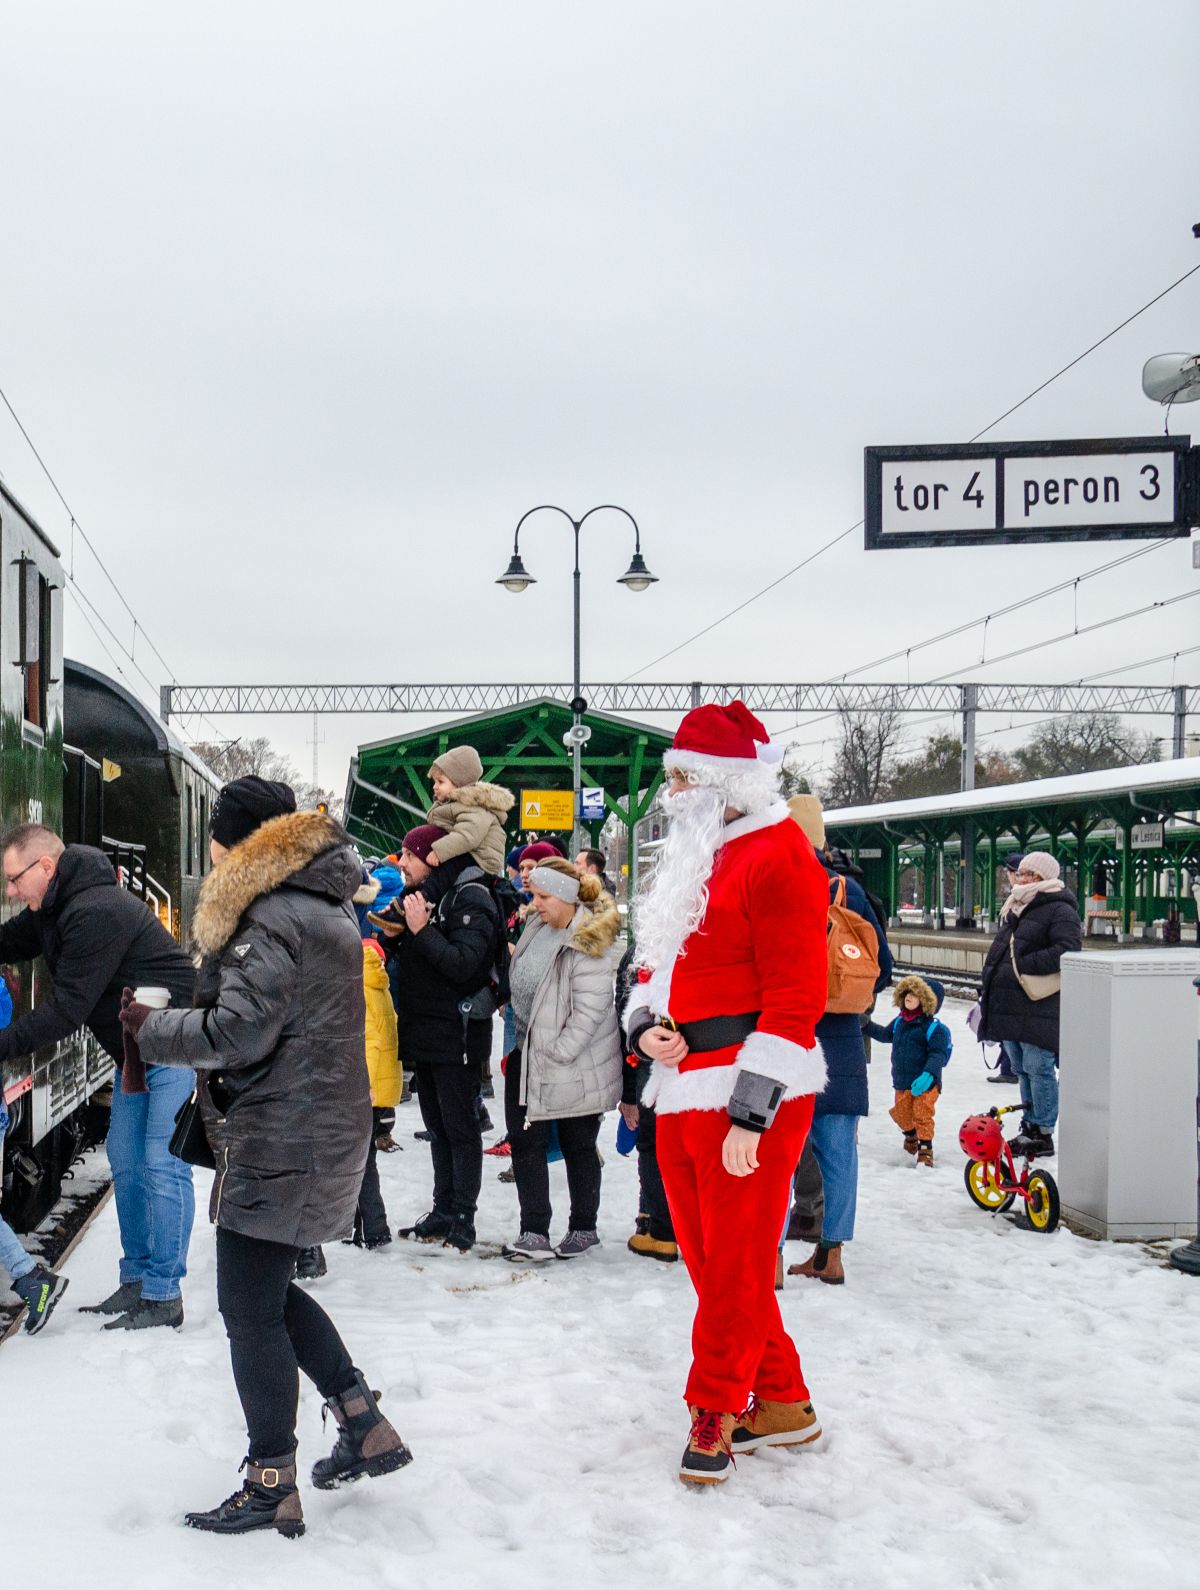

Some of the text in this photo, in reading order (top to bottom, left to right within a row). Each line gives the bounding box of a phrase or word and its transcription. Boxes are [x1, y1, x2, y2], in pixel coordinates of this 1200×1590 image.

[894, 464, 1161, 517] tor 4 peron 3
